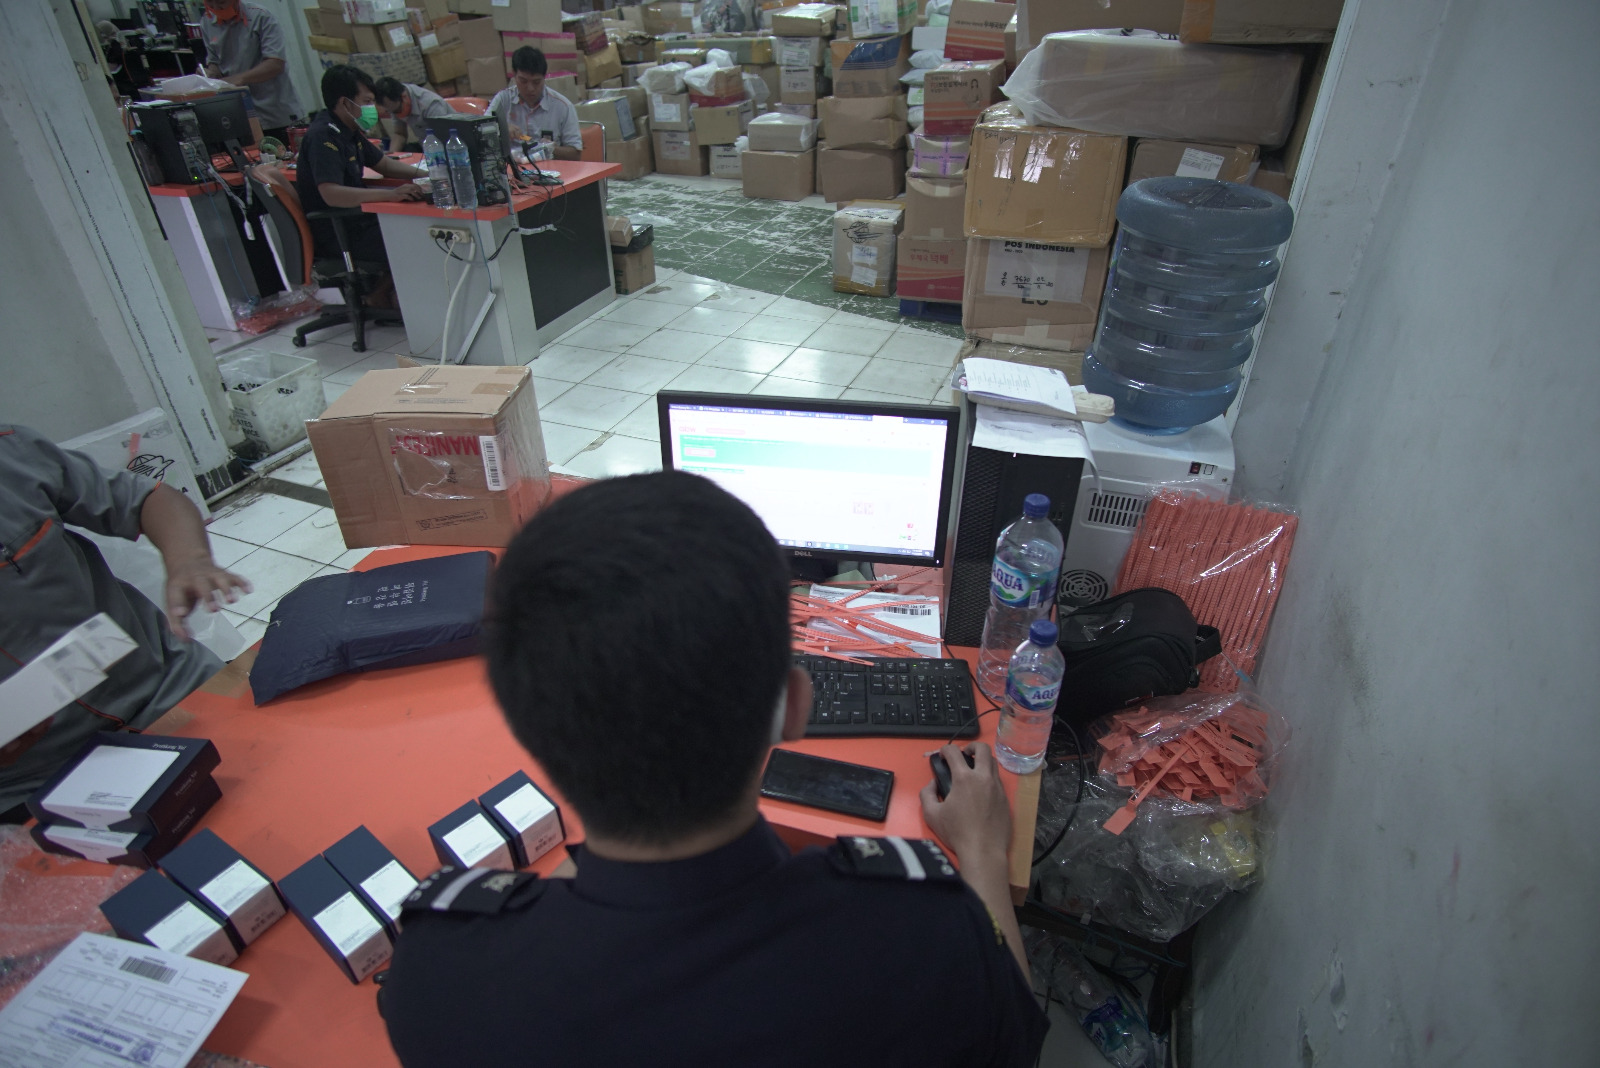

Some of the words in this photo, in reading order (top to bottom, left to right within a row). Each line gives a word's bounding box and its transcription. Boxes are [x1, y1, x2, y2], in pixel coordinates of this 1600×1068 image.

[1004, 240, 1022, 248] POS
[1025, 243, 1075, 253] INDONESIA
[794, 550, 813, 558] DELL
